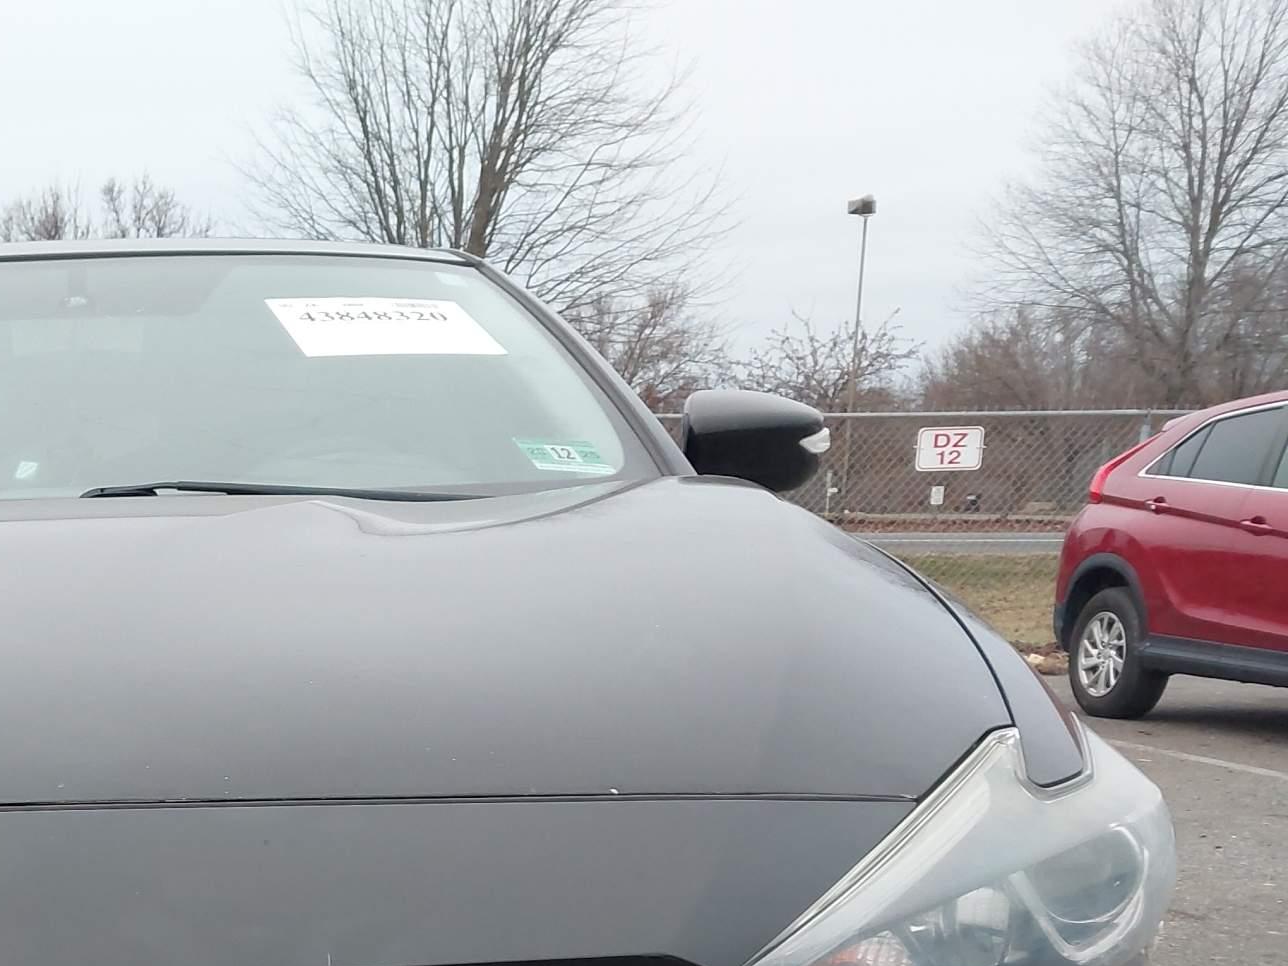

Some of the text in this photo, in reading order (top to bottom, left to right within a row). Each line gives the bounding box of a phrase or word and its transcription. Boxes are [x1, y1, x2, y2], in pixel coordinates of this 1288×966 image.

[298, 311, 449, 322] 43848320
[933, 432, 969, 449] DZ
[550, 446, 576, 460] 12
[936, 449, 962, 465] 12
